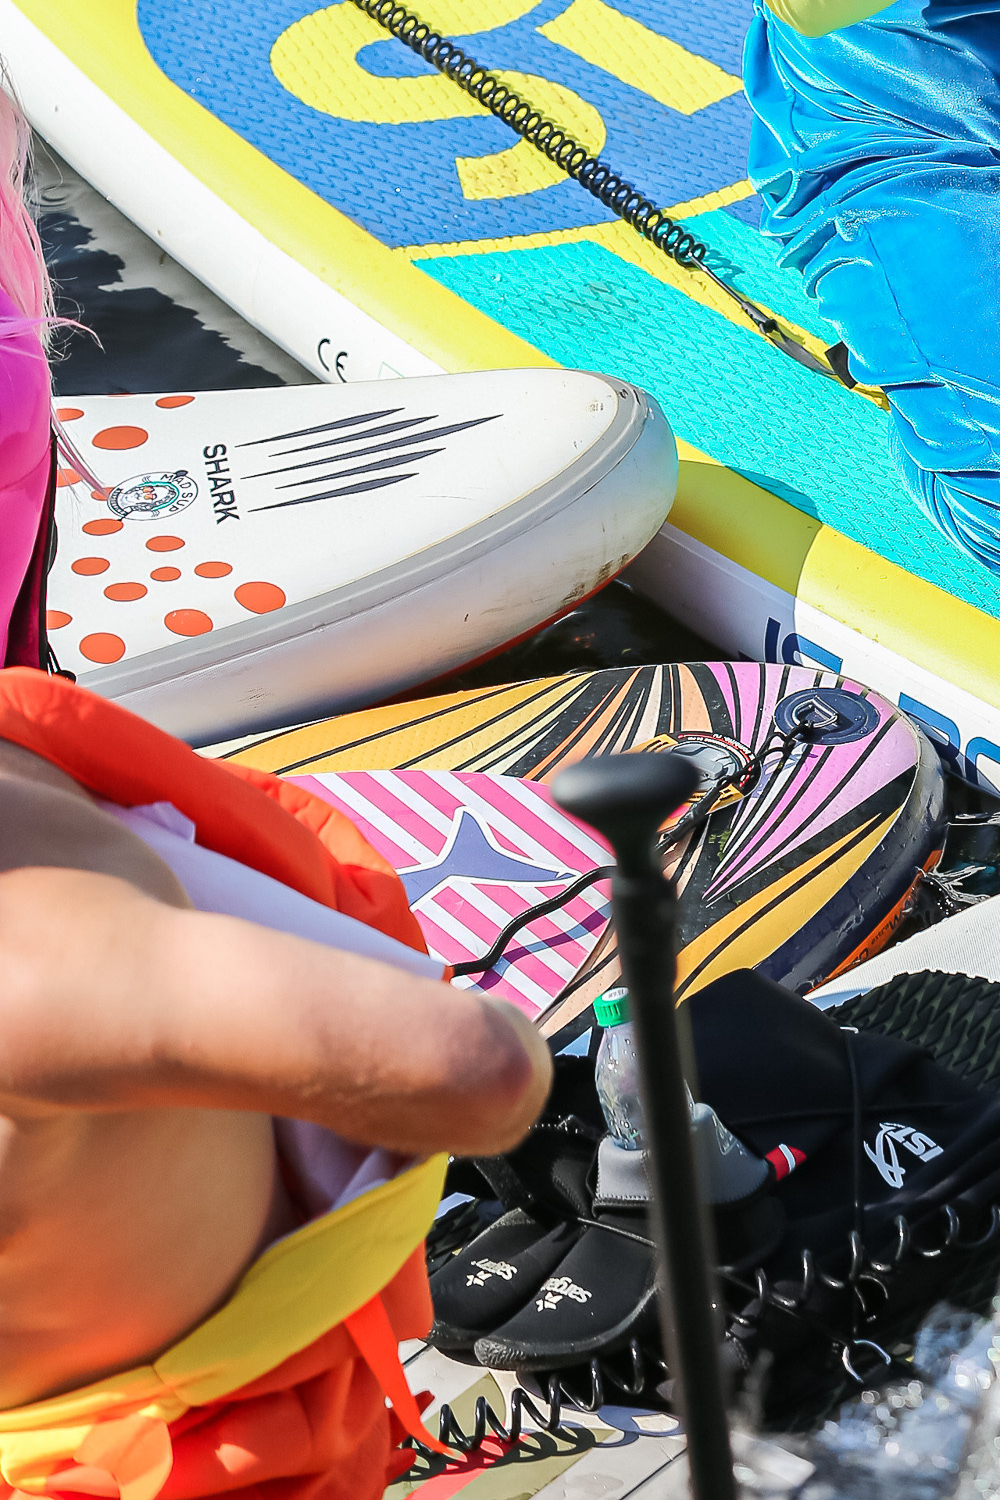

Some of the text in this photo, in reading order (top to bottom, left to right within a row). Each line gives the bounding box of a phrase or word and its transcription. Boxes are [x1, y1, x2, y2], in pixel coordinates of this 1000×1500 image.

[160, 473, 194, 513] MAD SUP
[202, 442, 241, 525] SHARK
